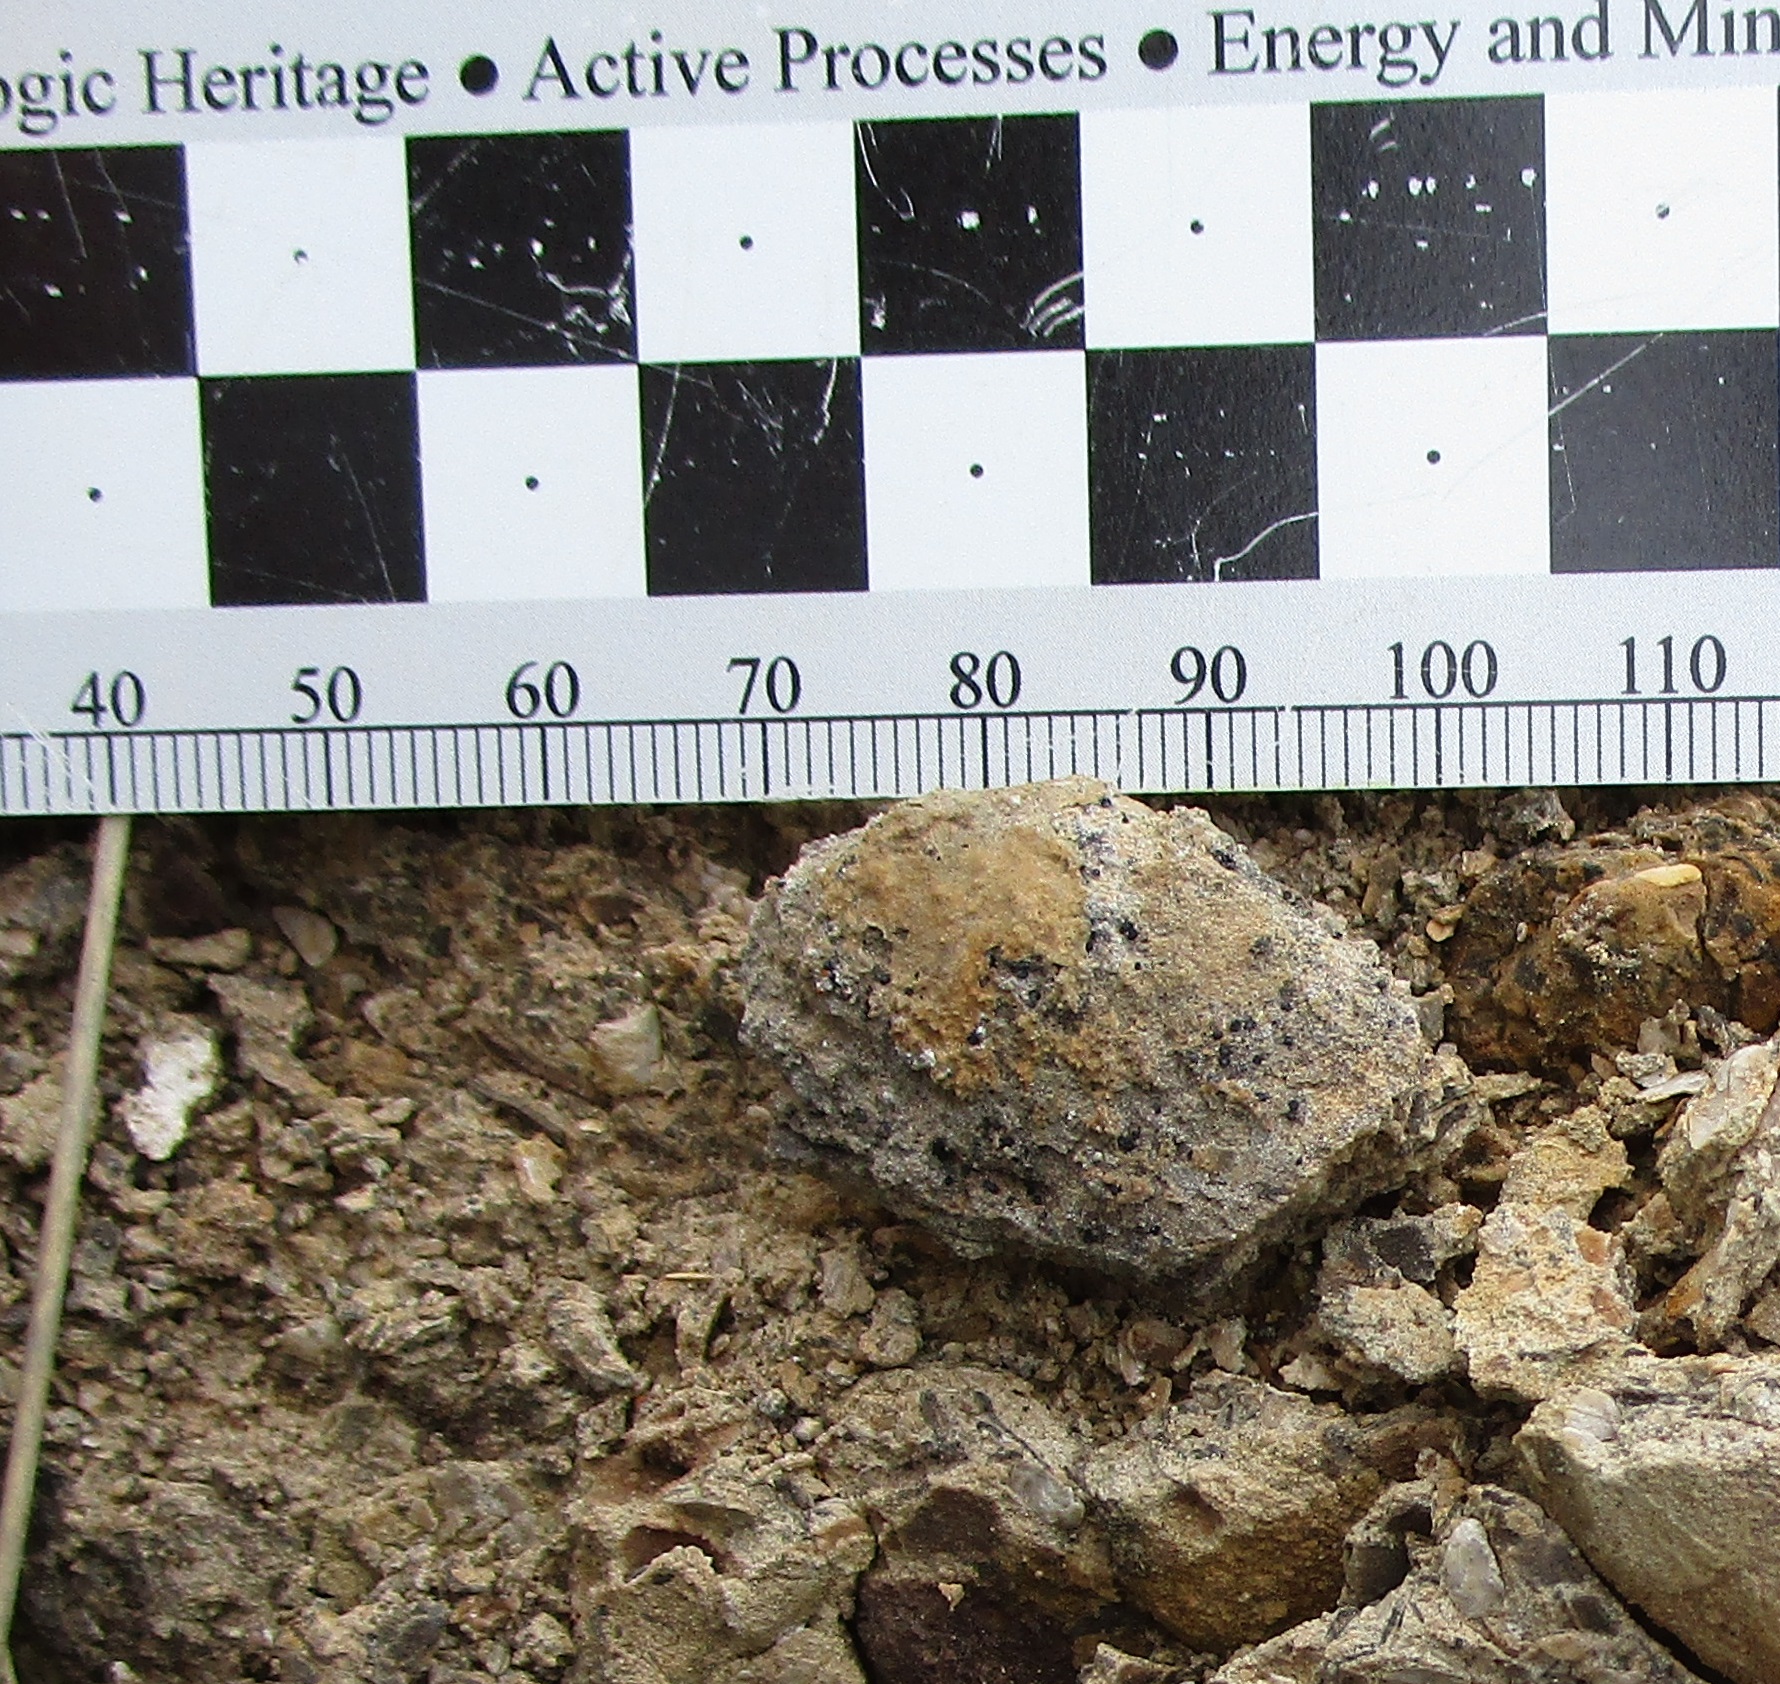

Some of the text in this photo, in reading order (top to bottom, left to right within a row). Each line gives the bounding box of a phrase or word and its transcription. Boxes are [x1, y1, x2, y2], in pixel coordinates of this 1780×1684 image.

[139, 44, 429, 126] Heritage
[523, 30, 749, 101] Active
[774, 28, 1107, 92] Processes
[1208, 10, 1460, 86] Energy
[1488, 0, 1613, 64] and
[71, 671, 145, 728] 40
[292, 666, 362, 724] 50
[505, 661, 580, 719] 60
[727, 656, 801, 714] 70
[950, 651, 1021, 709] 80
[1170, 645, 1247, 705] 90
[1388, 640, 1498, 699] 100
[1620, 635, 1727, 694] 110
